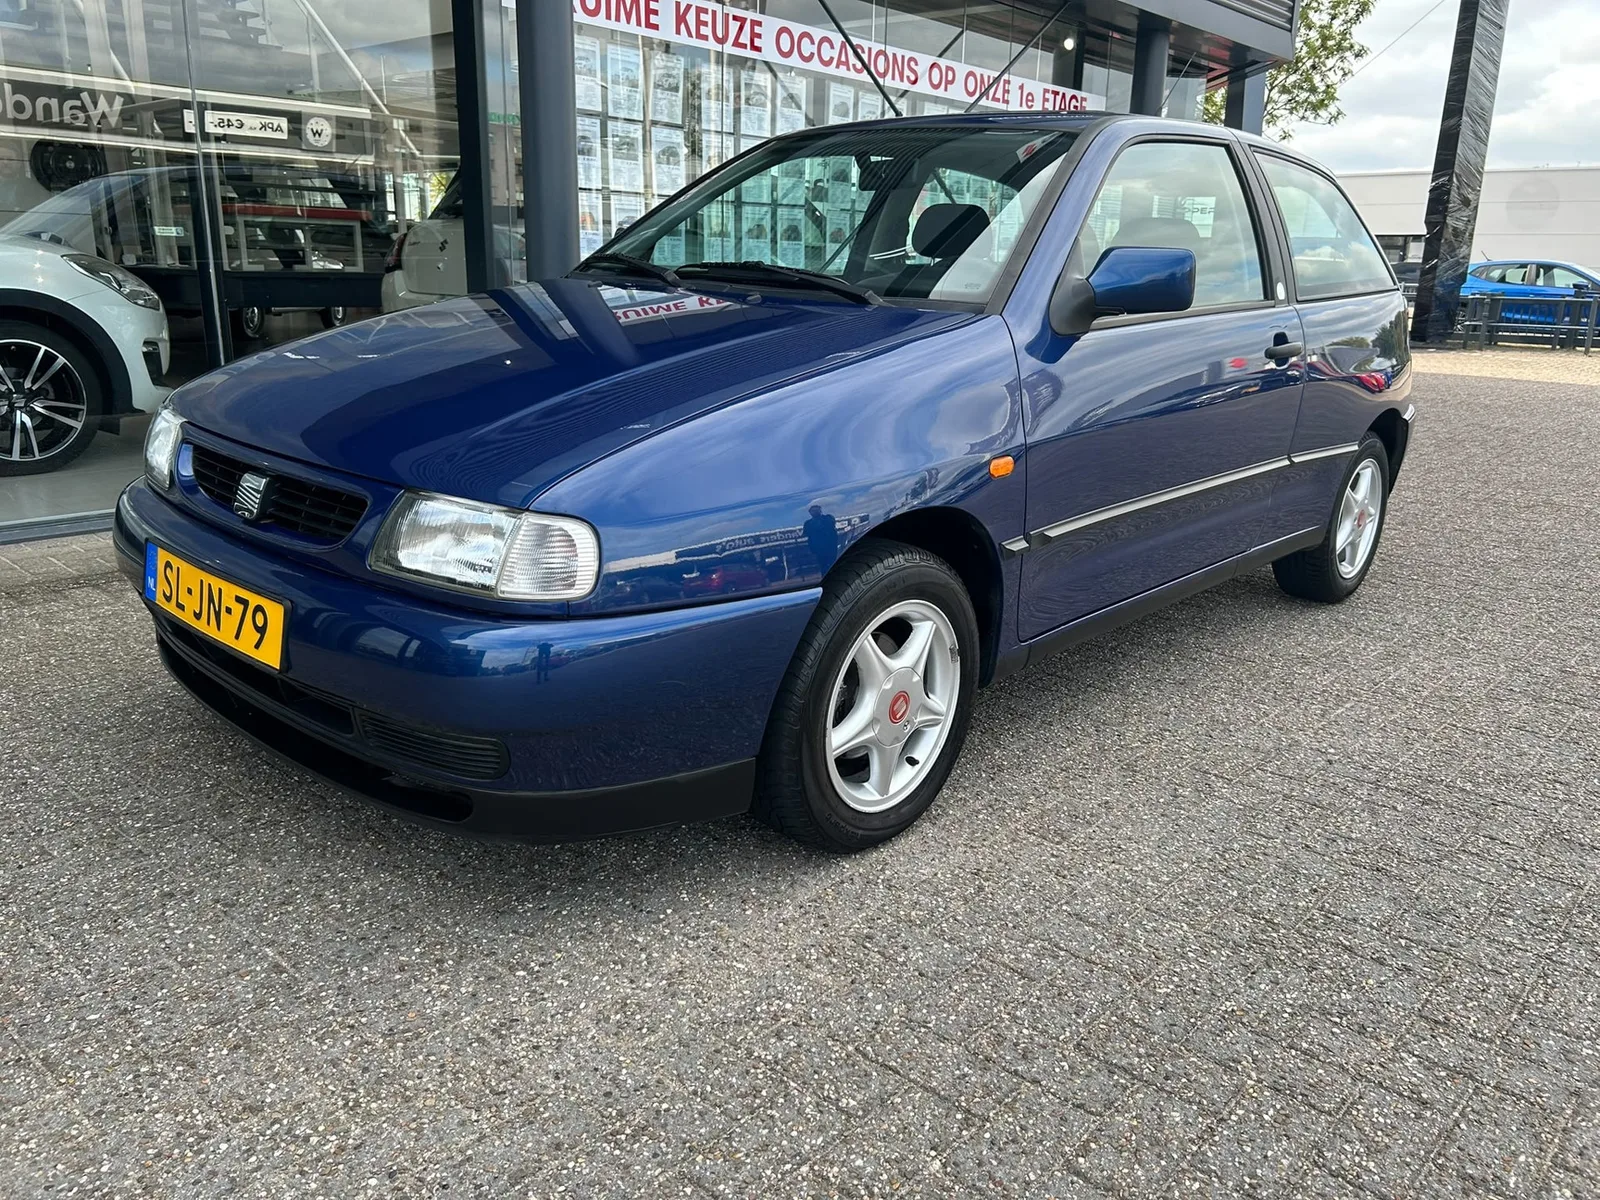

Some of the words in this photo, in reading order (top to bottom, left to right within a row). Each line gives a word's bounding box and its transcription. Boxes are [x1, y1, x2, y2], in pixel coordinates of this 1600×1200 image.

[573, 0, 660, 31] UIME
[674, 1, 763, 53] KEUZE
[775, 26, 919, 86] OCCASIONS
[928, 61, 956, 92] OP
[963, 70, 1012, 105] ONZE
[1018, 83, 1035, 109] 1e
[1042, 88, 1088, 111] ETAGE
[310, 127, 324, 138] W
[147, 576, 156, 591] NL
[162, 560, 269, 650] SL-JN-79
